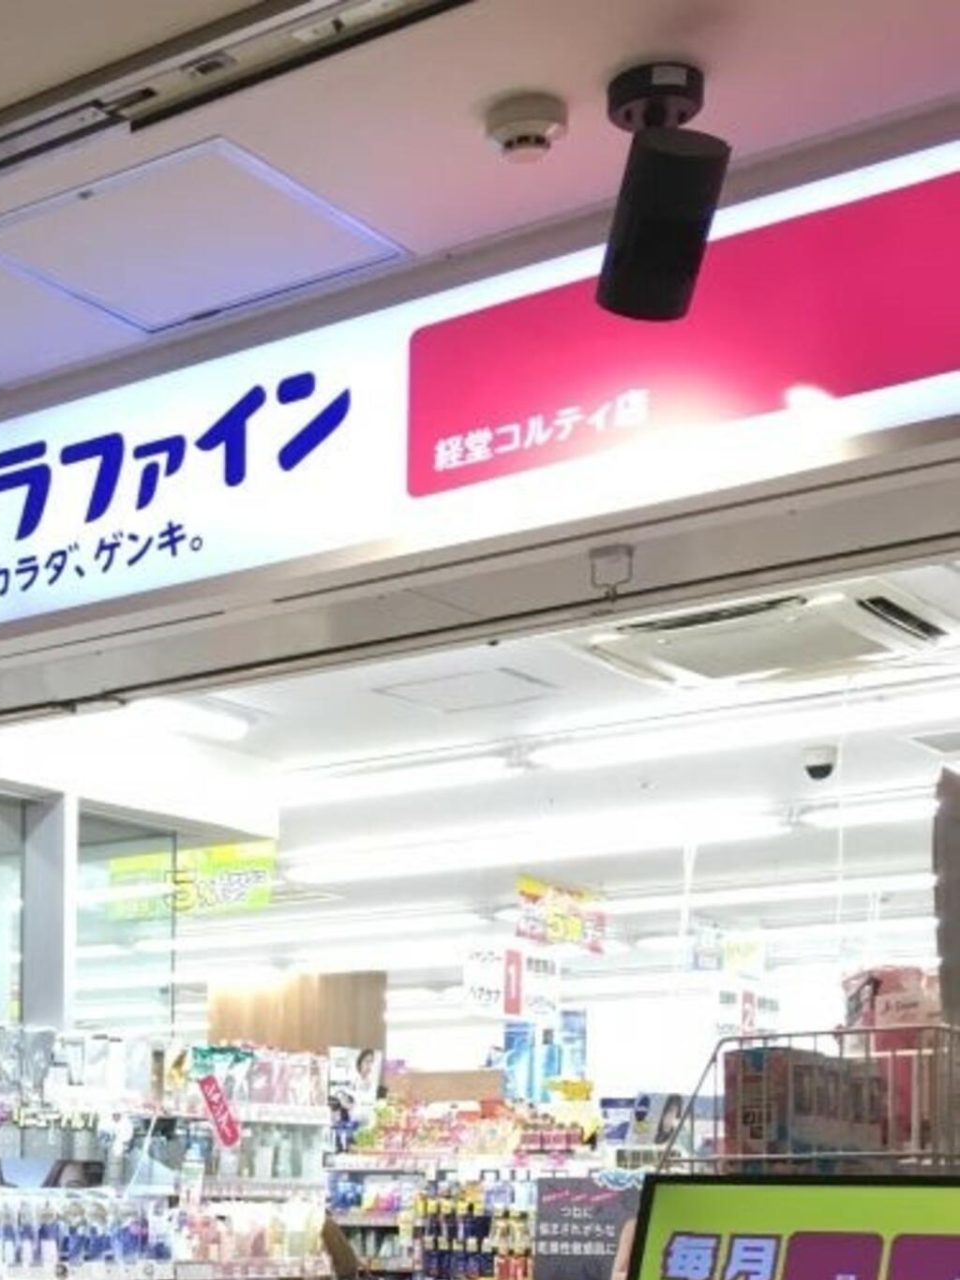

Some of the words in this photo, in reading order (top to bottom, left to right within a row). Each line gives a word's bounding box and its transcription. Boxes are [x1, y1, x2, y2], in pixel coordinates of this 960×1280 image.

[434, 388, 651, 472] 経堂コルティ店
